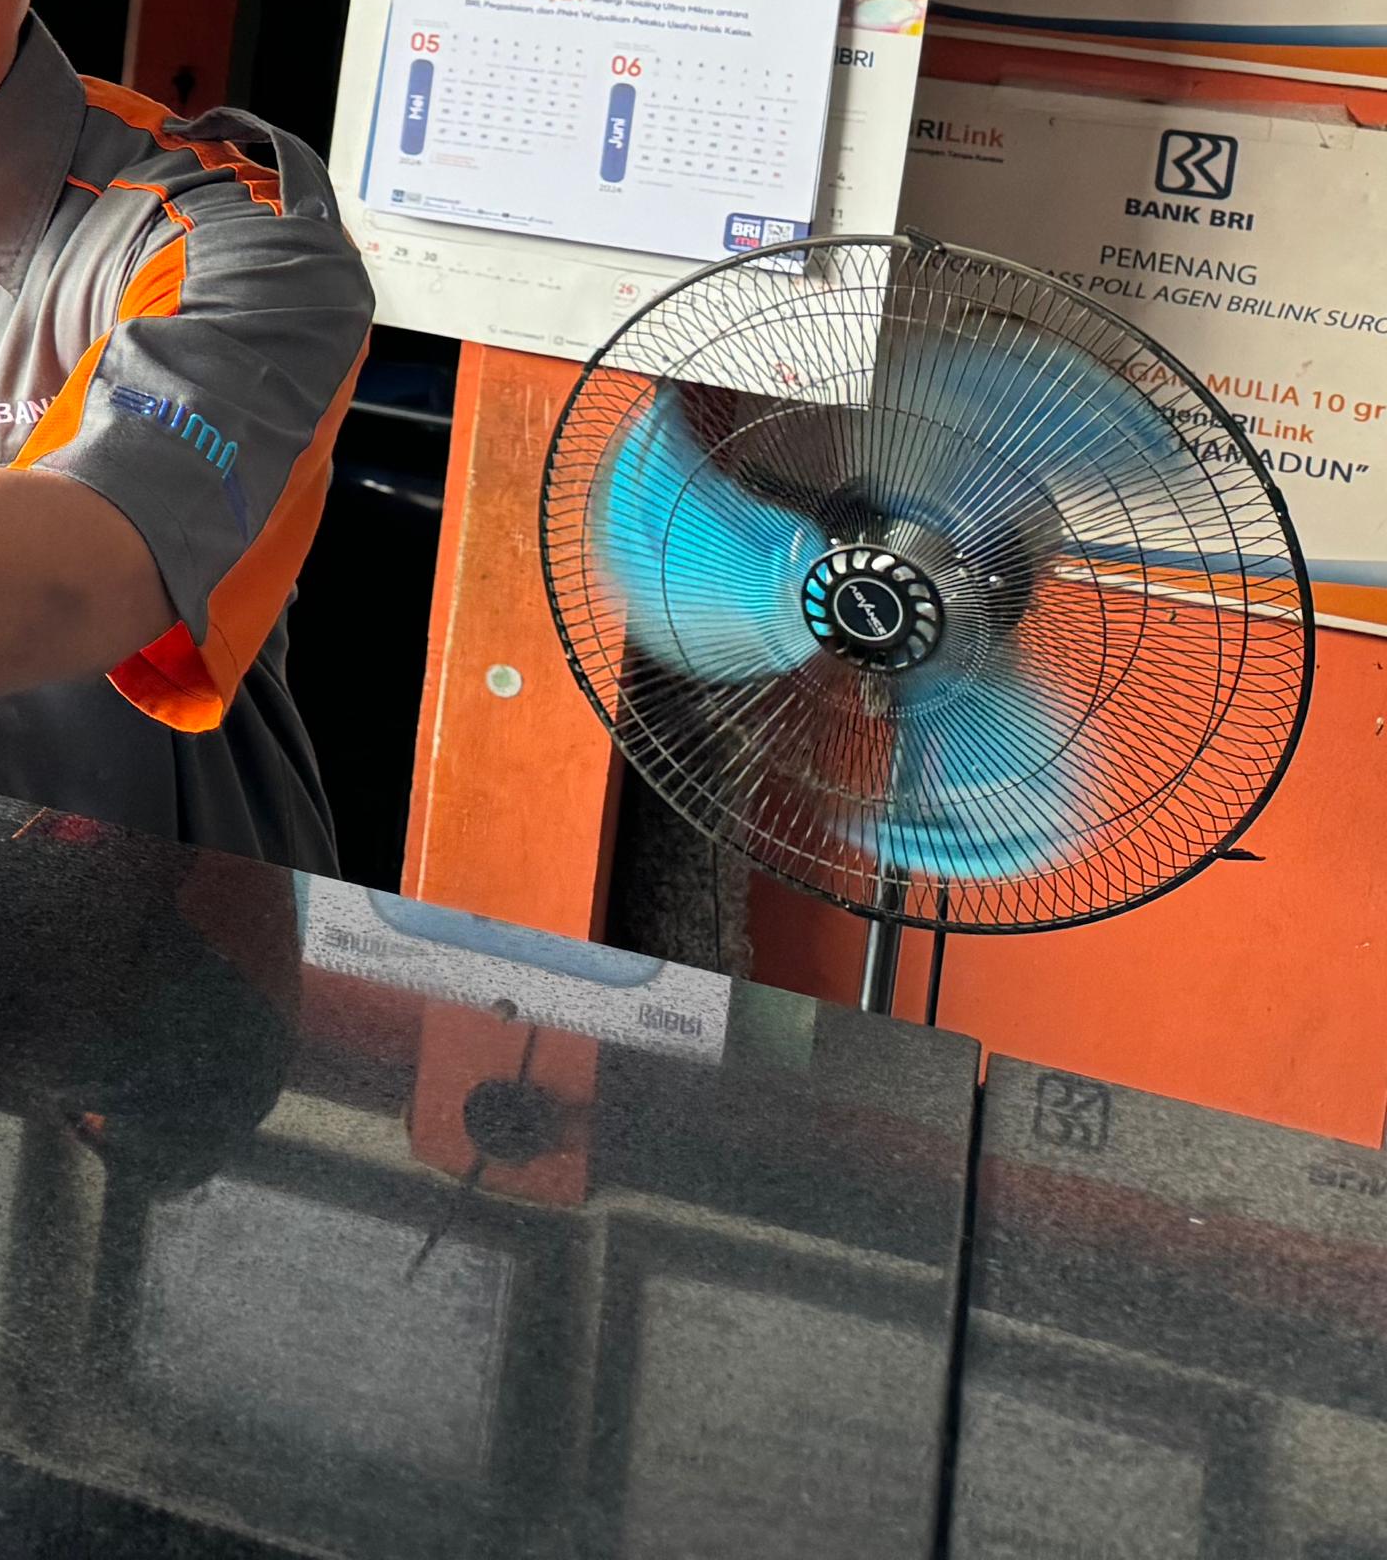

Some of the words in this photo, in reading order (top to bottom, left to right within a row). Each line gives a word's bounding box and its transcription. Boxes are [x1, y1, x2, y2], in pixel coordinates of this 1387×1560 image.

[411, 32, 440, 53] 05
[611, 56, 641, 78] 06
[409, 94, 423, 120] Mei
[608, 118, 625, 149] Juni
[1126, 198, 1201, 223] BANK
[1209, 208, 1255, 231] BRI
[1100, 246, 1257, 286] PEMENANG
[1089, 275, 1148, 300] POLL
[1154, 285, 1223, 310] AGEN
[1227, 296, 1321, 325] BRILINK
[1207, 373, 1300, 407] MULIA
[1311, 391, 1345, 414] 10
[1354, 402, 1386, 422] gr
